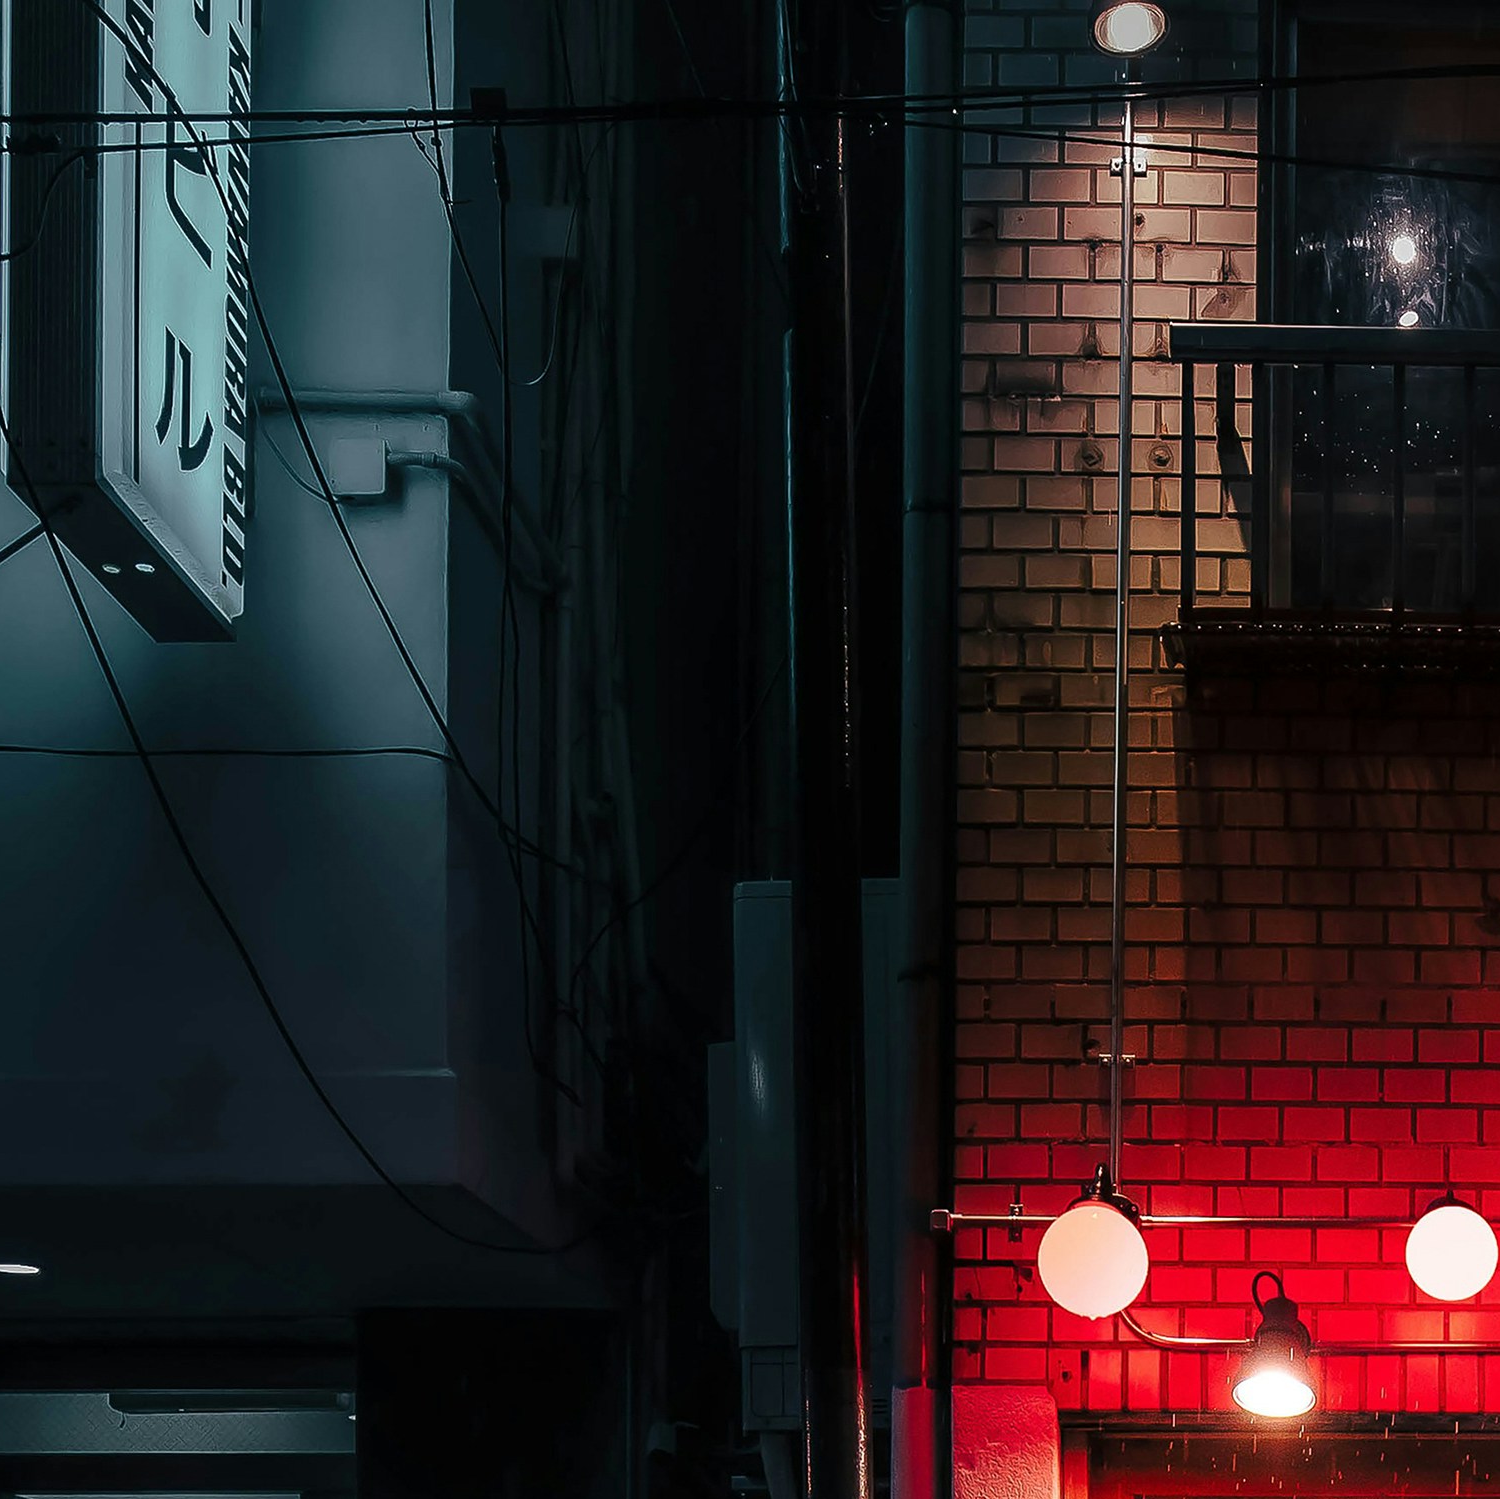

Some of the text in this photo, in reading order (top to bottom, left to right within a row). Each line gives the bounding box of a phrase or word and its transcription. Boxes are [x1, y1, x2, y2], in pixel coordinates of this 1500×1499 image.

[157, 0, 216, 470] ビル
[222, 22, 250, 589] KAWAMURA BLD.
